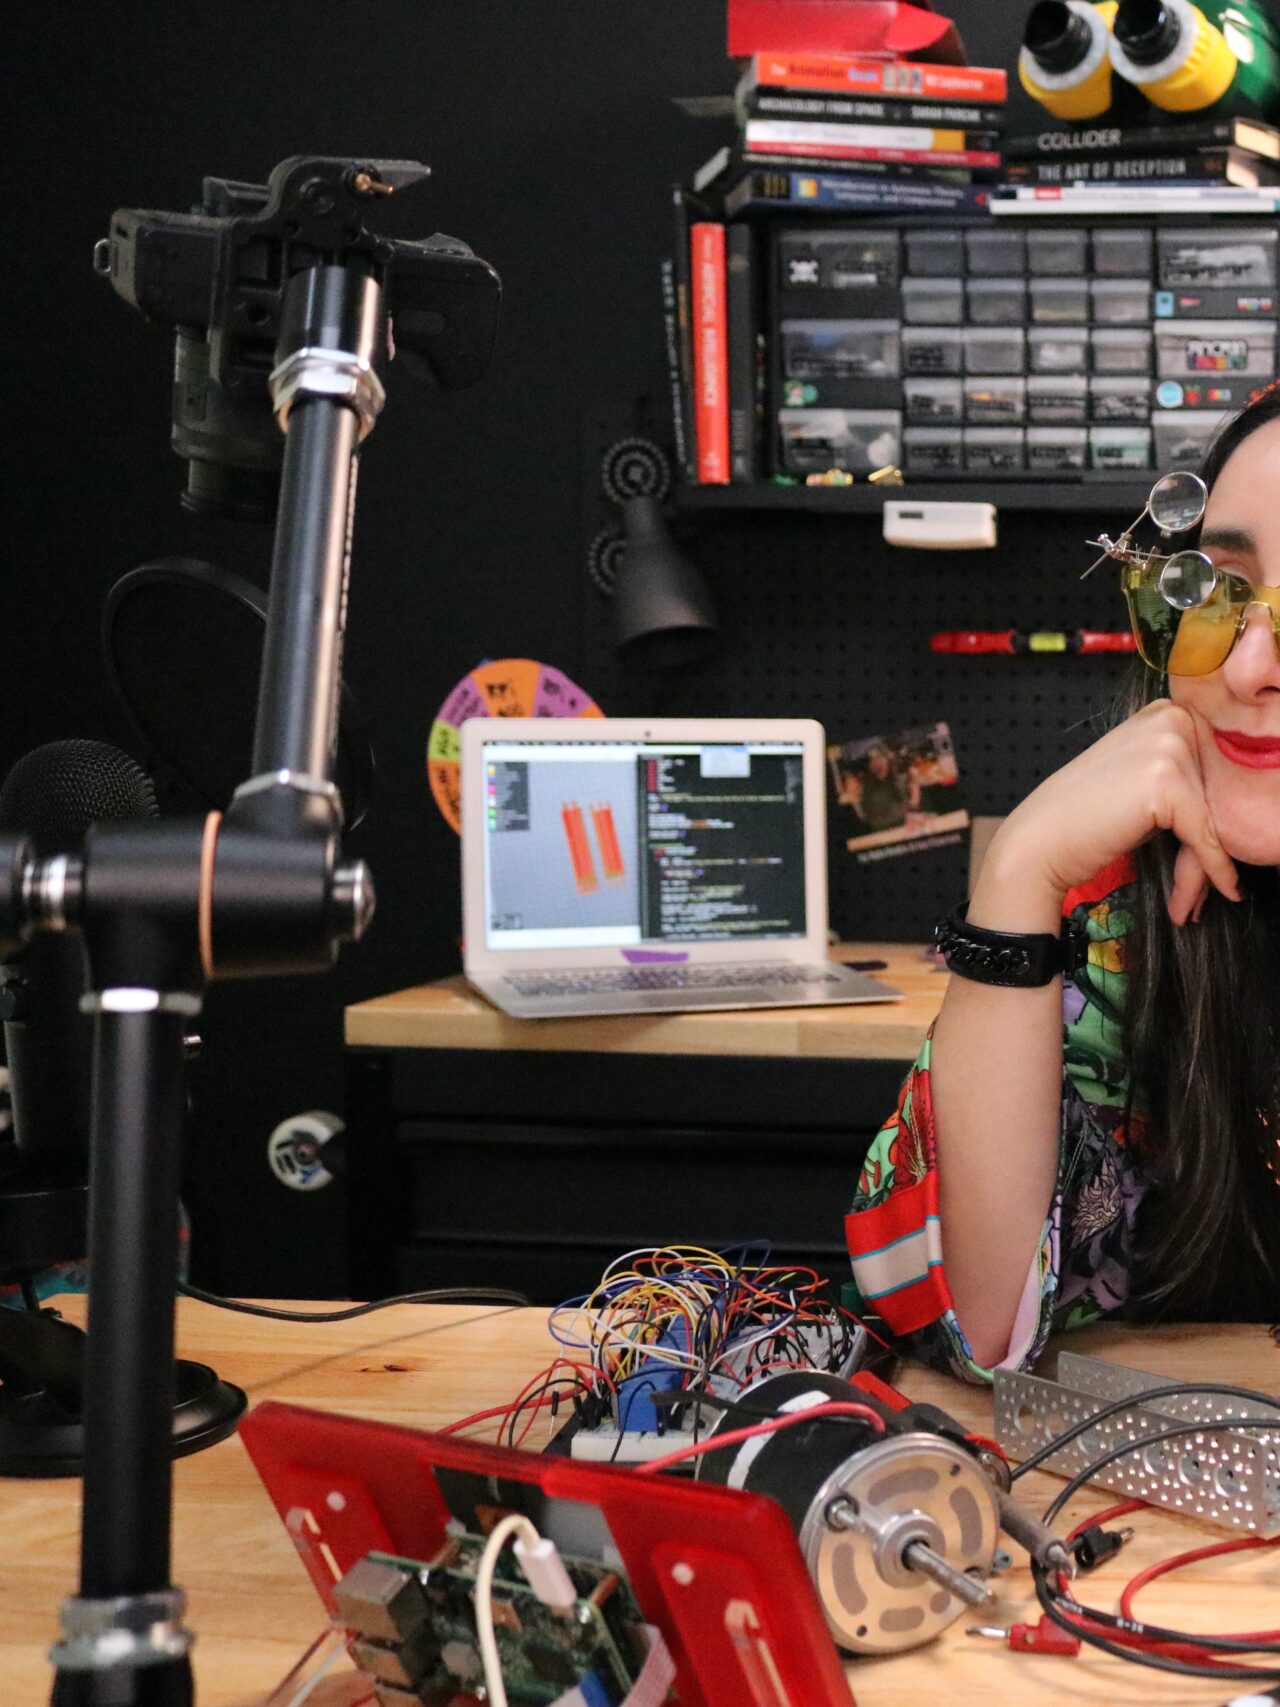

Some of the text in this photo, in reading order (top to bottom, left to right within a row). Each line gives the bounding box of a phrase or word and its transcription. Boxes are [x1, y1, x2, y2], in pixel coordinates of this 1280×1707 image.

[1038, 129, 1122, 151] COLLIDER
[1038, 164, 1061, 181] THE
[1065, 162, 1089, 180] ART
[1092, 161, 1108, 179] OF
[1113, 159, 1186, 178] DECEPTION
